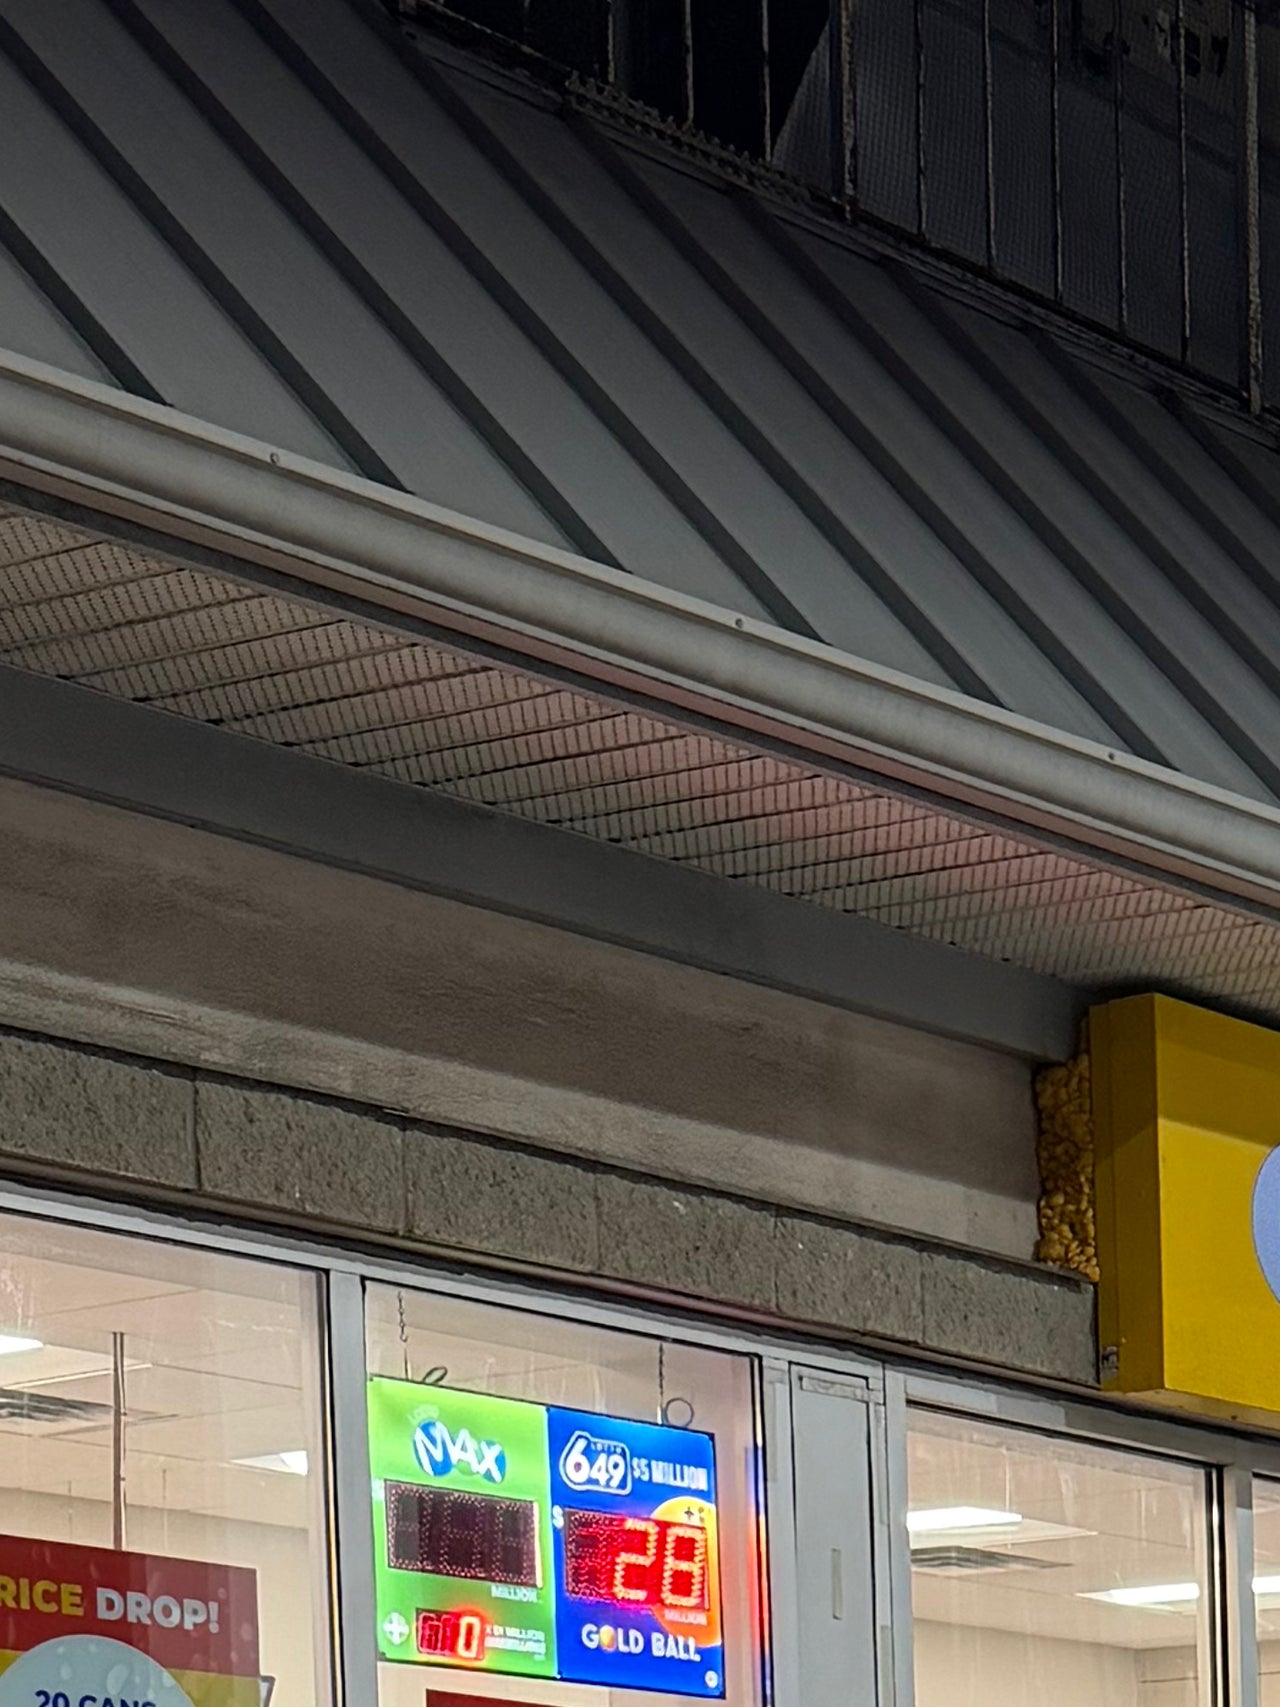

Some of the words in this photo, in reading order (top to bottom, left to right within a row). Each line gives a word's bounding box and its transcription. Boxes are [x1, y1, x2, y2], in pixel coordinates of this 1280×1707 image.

[414, 1420, 502, 1484] MAX
[651, 1460, 708, 1491] MILLION
[612, 1517, 706, 1607] 28
[0, 1575, 84, 1616] RICE
[96, 1587, 219, 1634] DROP!
[651, 1631, 701, 1662] BALL
